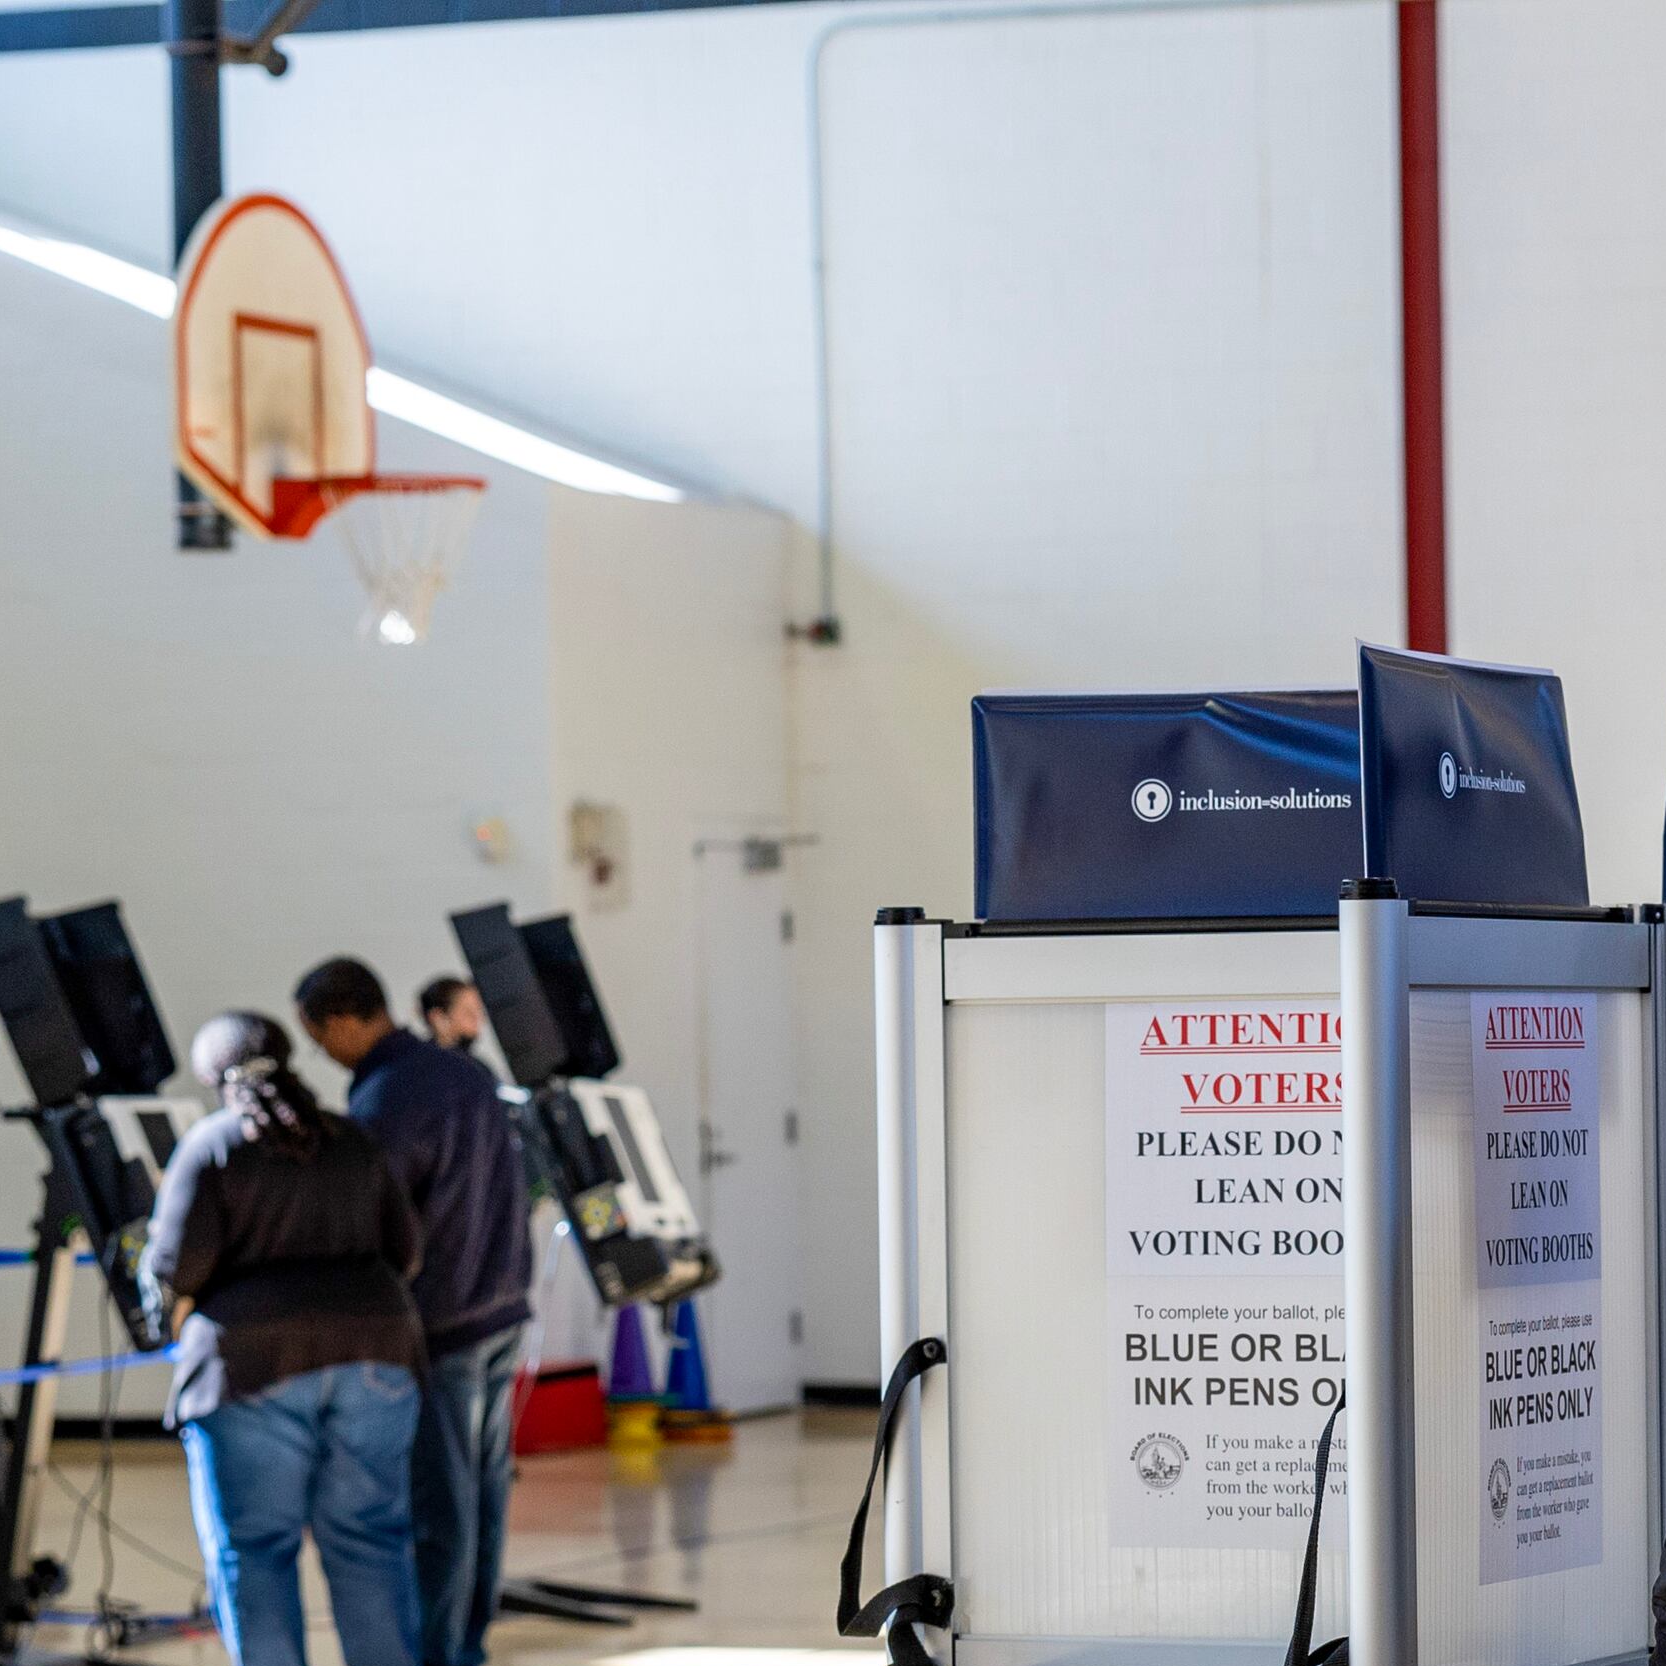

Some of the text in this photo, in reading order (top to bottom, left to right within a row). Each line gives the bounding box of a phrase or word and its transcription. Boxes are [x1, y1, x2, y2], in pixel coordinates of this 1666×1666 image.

[1142, 1012, 1341, 1046] ATTENTI
[1486, 1007, 1584, 1040] ATTENTION
[1503, 1069, 1571, 1103] VOTERS
[1136, 1131, 1263, 1157] PLEASE
[1274, 1130, 1322, 1155] DO
[1487, 1129, 1588, 1159] PLEASE DO NOT
[1195, 1177, 1342, 1203] LEAN ON
[1511, 1179, 1568, 1210] LEAN ON
[1129, 1230, 1344, 1256] VOTING BOO
[1486, 1233, 1593, 1266] VOTING BOOTHS
[1134, 1305, 1345, 1323] To complete your ballot, ple
[1489, 1313, 1592, 1338] To complete your ballot, please use
[1126, 1334, 1218, 1361] BLUE
[1232, 1333, 1282, 1362] OR
[1486, 1341, 1596, 1382] BLUE OR BLACK
[1135, 1378, 1193, 1405] INK
[1206, 1378, 1298, 1406] PENS
[1490, 1387, 1593, 1430] INK PENS ONLY
[1159, 1432, 1189, 1461] ELECTIONS
[1206, 1434, 1218, 1449] If
[1222, 1439, 1248, 1452] you
[1254, 1435, 1293, 1449] make
[1298, 1440, 1306, 1449] a
[1206, 1460, 1270, 1475] can get a
[1523, 1460, 1534, 1475] you
[1536, 1453, 1551, 1469] make
[1553, 1456, 1555, 1467] a
[1581, 1451, 1591, 1467] you
[1207, 1480, 1268, 1494] from the
[1517, 1470, 1593, 1499] can get a replacement ballot
[1206, 1503, 1314, 1520] you your ballo
[1517, 1497, 1589, 1520] from the worker who gave
[1517, 1534, 1528, 1549] you
[1529, 1530, 1542, 1547] your
